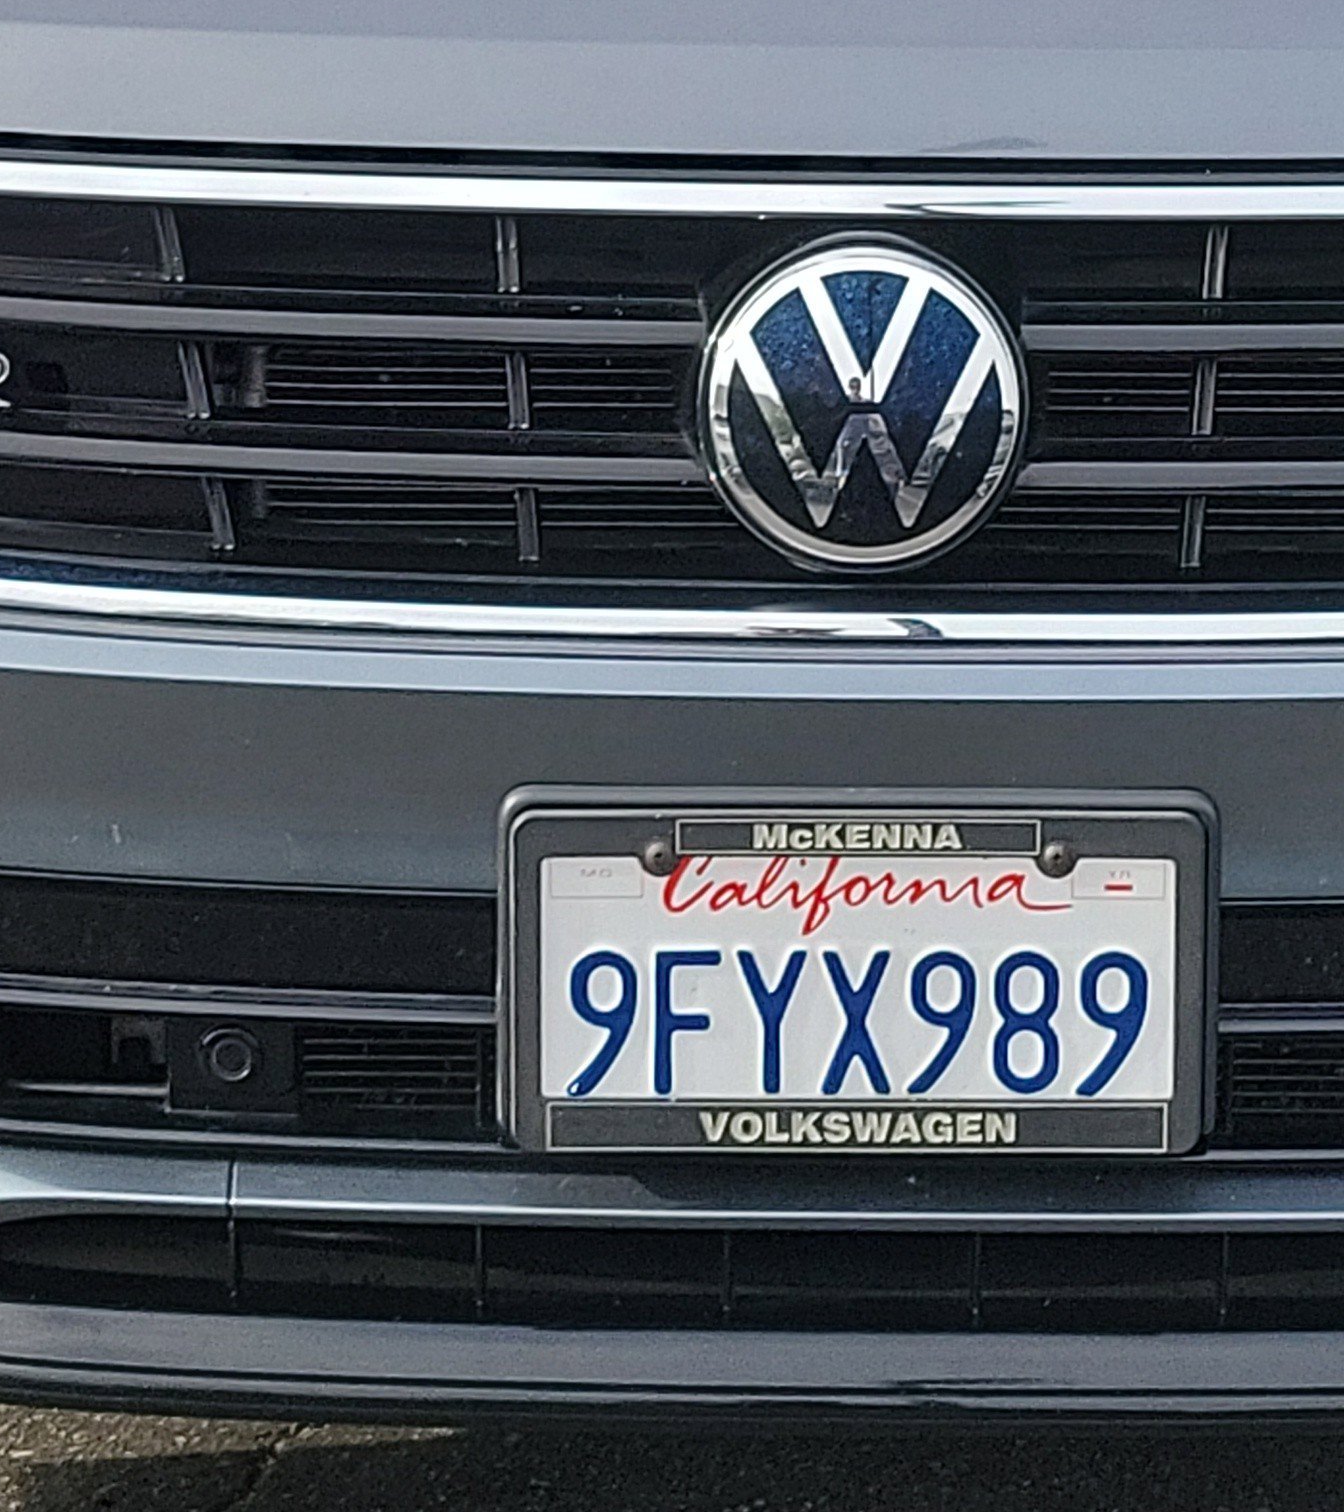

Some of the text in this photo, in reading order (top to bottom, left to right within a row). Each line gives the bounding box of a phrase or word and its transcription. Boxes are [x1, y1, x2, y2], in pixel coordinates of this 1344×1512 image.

[714, 254, 1013, 552] VW
[752, 823, 963, 850] McKENNA
[663, 856, 1073, 936] California
[566, 950, 1149, 1096] 9FYX989
[699, 1110, 1017, 1144] VOLKSWAGEN
